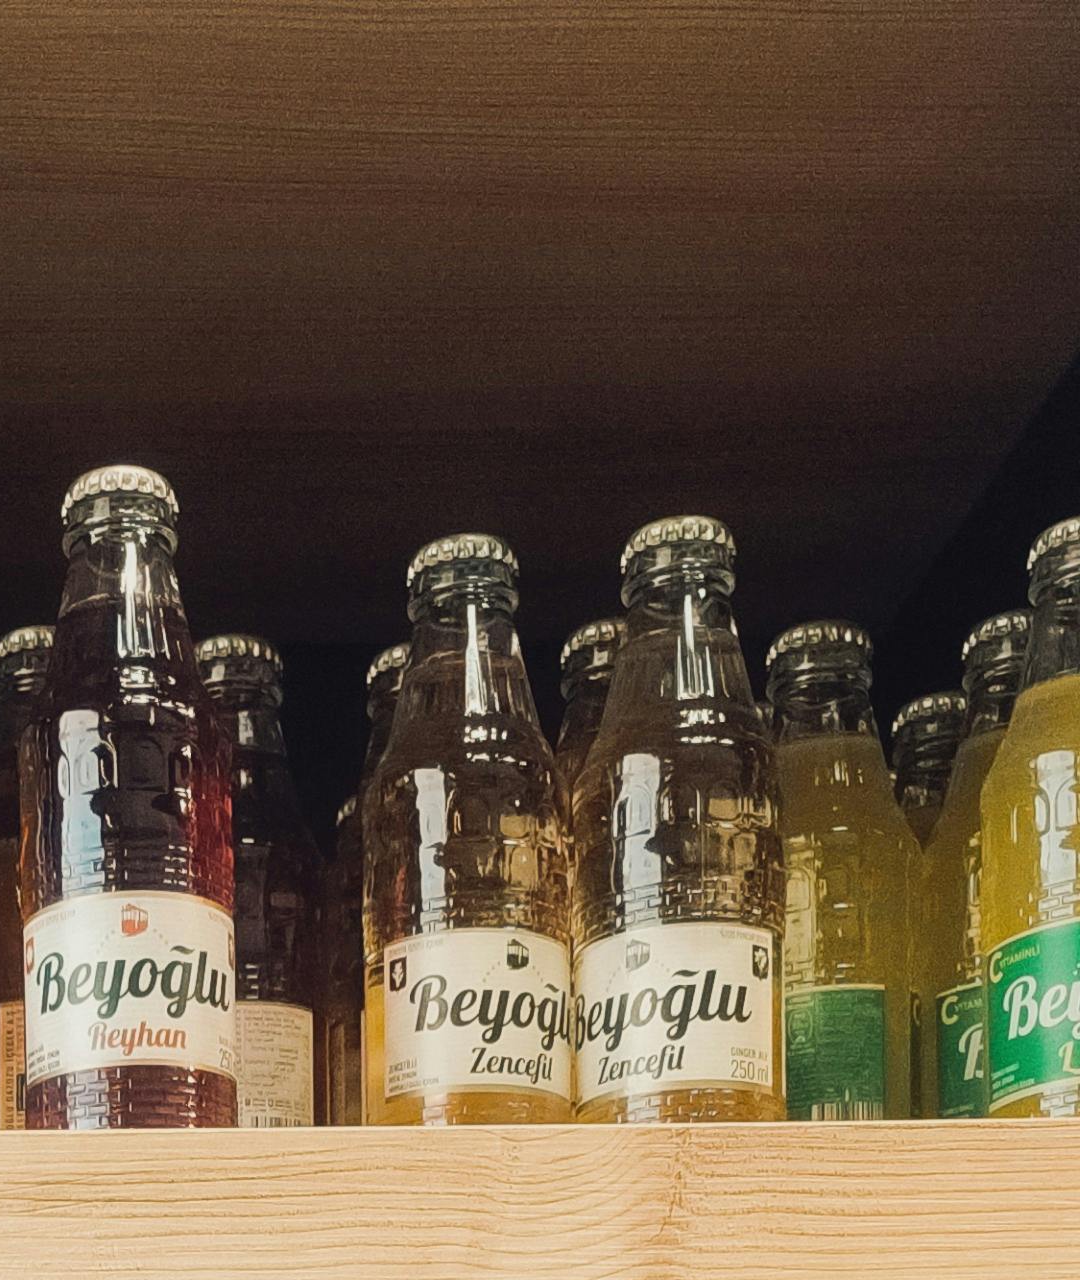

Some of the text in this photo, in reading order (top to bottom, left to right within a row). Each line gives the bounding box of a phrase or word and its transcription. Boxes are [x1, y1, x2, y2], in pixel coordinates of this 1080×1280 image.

[37, 945, 230, 1019] Beyoğlu
[575, 969, 752, 1053] Beyoğlu
[88, 1020, 188, 1057] Reyhan
[470, 1047, 553, 1085] Zencefil
[597, 1045, 685, 1086] Zencefil
[730, 1060, 755, 1081] 250
